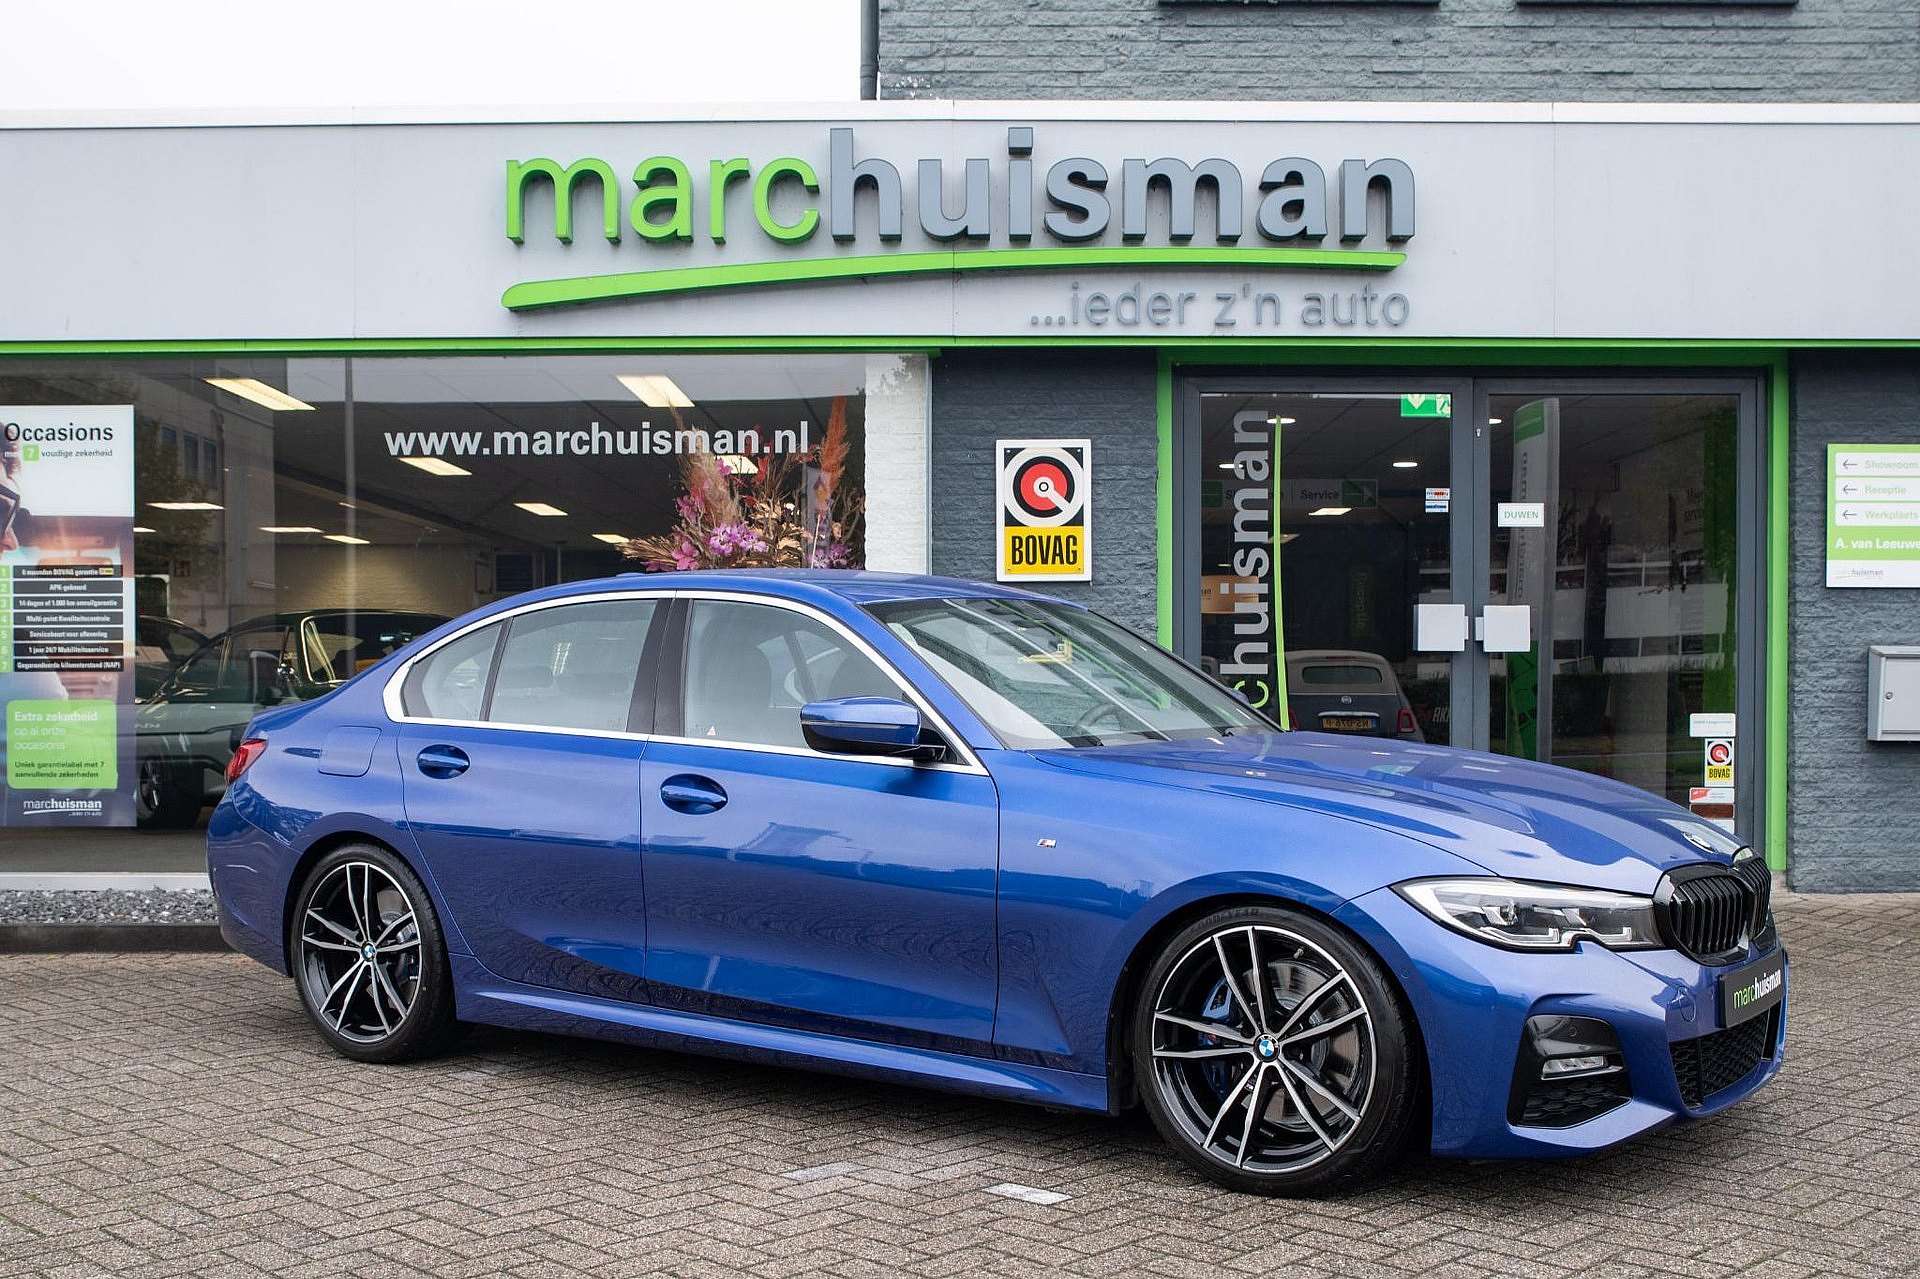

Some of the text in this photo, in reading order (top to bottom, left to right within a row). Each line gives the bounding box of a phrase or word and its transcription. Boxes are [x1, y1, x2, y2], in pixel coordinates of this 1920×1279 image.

[507, 127, 1416, 248] marchuisman
[1214, 283, 1281, 326] z'n
[1300, 283, 1411, 326] auto
[4, 422, 113, 442] Occasions
[384, 421, 809, 456] www.marchuisman.nl
[26, 448, 35, 459] 7
[41, 450, 73, 459] voudige
[75, 449, 113, 458] zekerheid
[1864, 460, 1919, 470] Showroom
[1301, 489, 1340, 500] Service
[1864, 485, 1906, 495] Receptie
[1504, 510, 1539, 519] DUWEN
[1864, 510, 1919, 520] Werkplaats
[1010, 534, 1078, 566] BOVAG
[1851, 540, 1872, 549] van
[15, 712, 42, 721] Extra
[37, 761, 82, 769] garantielabel
[1709, 768, 1730, 779] BOVAG
[23, 798, 102, 809] marchuisman
[1733, 969, 1781, 1010] marchuisman
